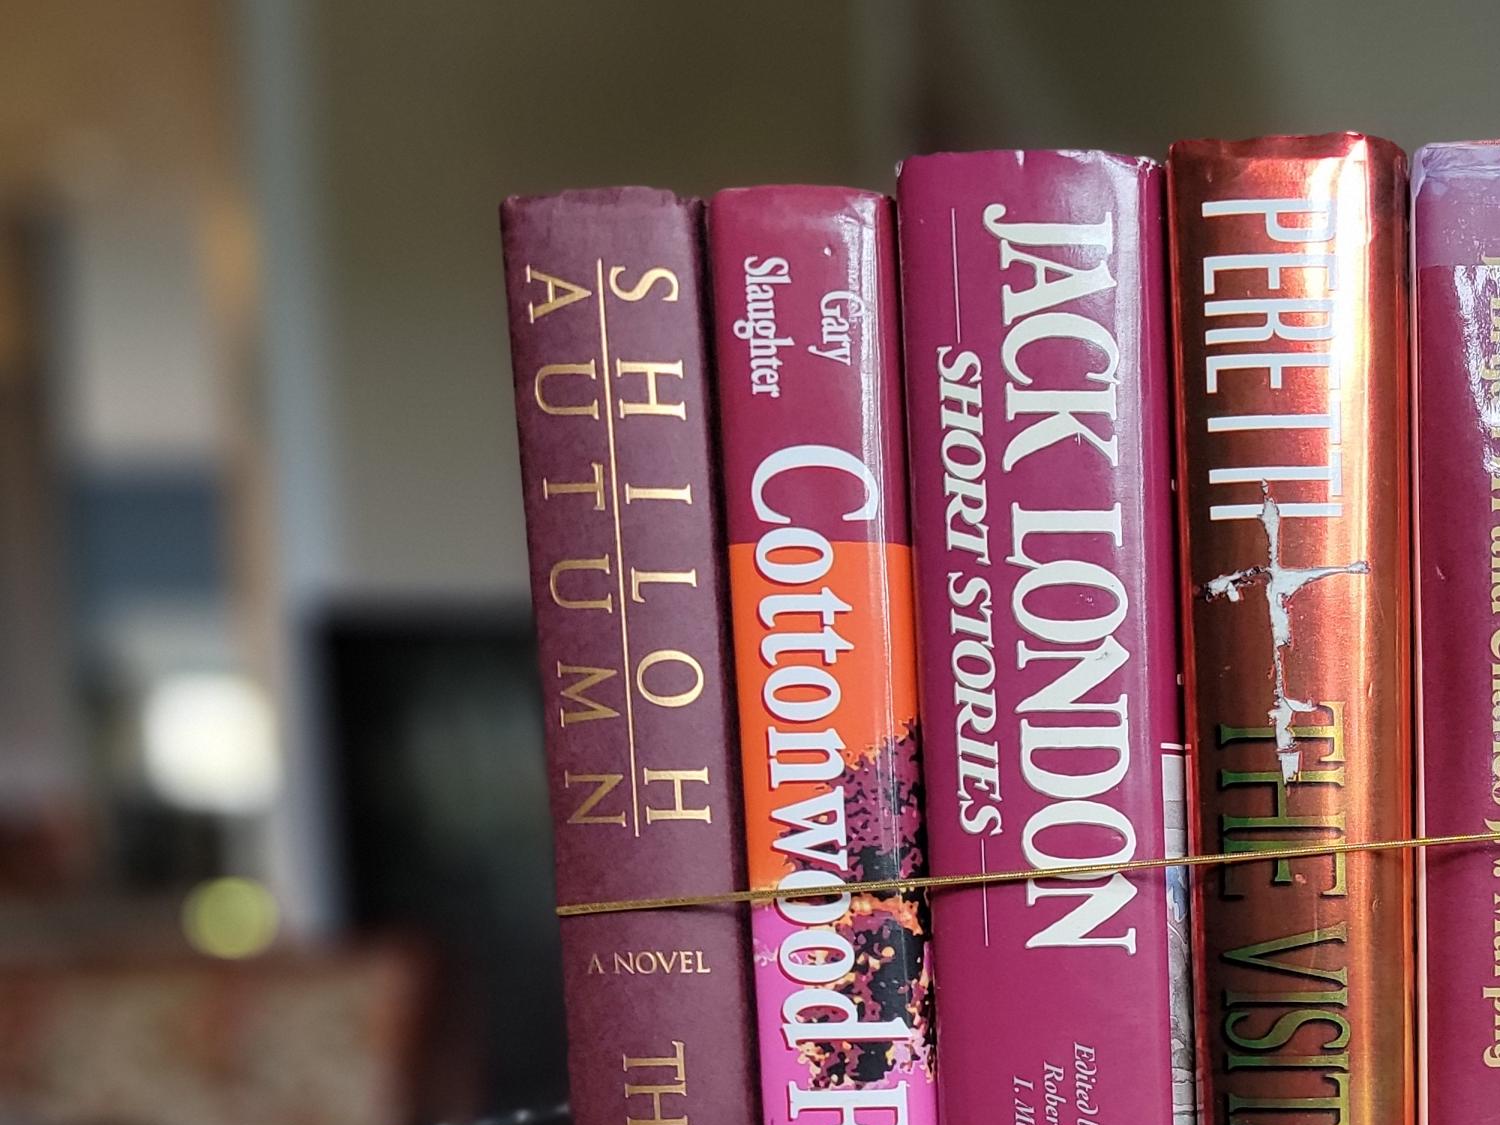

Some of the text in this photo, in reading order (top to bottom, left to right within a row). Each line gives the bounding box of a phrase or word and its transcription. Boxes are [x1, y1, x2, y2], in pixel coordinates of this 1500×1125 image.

[733, 255, 795, 398] Slaughter
[808, 290, 864, 366] Gary
[1201, 198, 1343, 521] PERETTI
[525, 264, 627, 828] AUTUMN
[608, 264, 713, 825] SHILOH
[936, 345, 1004, 837] SHORT STORIES
[983, 202, 1137, 955] JACK LONDON
[1219, 701, 1348, 897] THE
[587, 951, 711, 975] A NOVEL
[1013, 1076, 1034, 1093] I.
[1075, 1042, 1099, 1116] Edited
